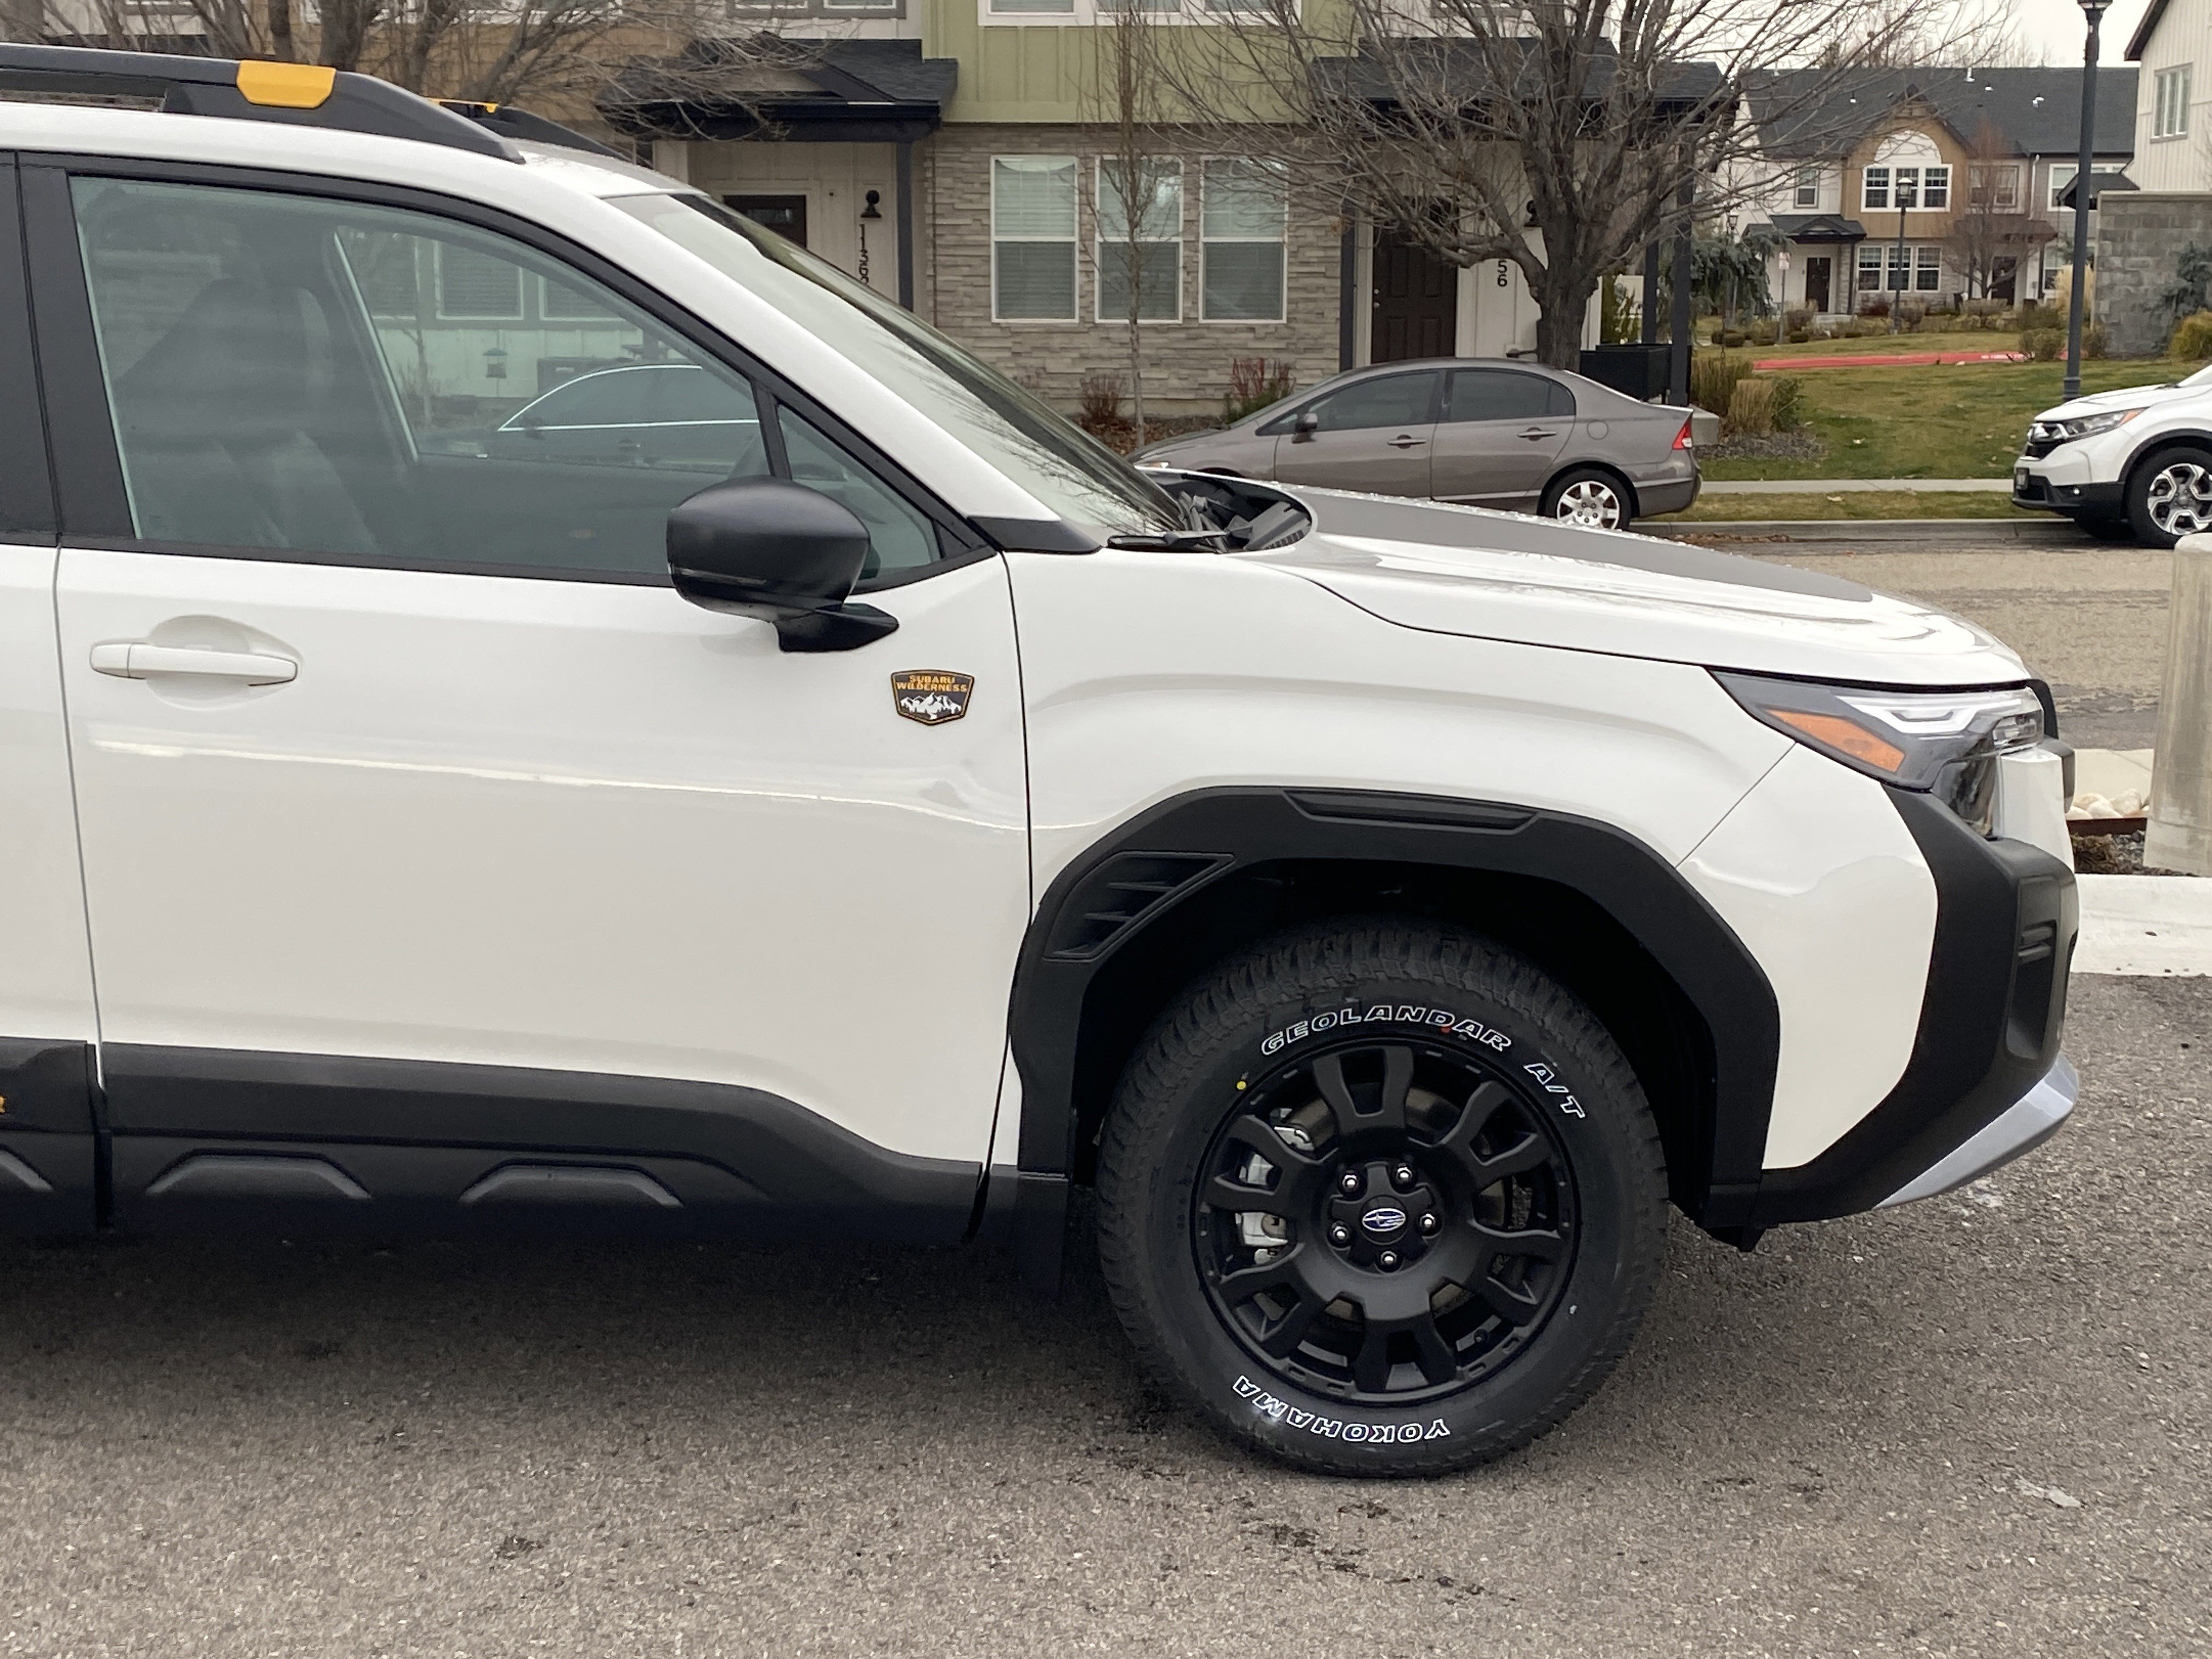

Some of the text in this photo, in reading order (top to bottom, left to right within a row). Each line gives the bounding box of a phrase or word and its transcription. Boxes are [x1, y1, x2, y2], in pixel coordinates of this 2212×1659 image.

[896, 682, 967, 692] WILDERNESS
[909, 675, 955, 684] SUBARU
[1261, 1005, 1585, 1119] GEOLANDAR A/T
[1232, 1375, 1451, 1443] YOKOHAMA
